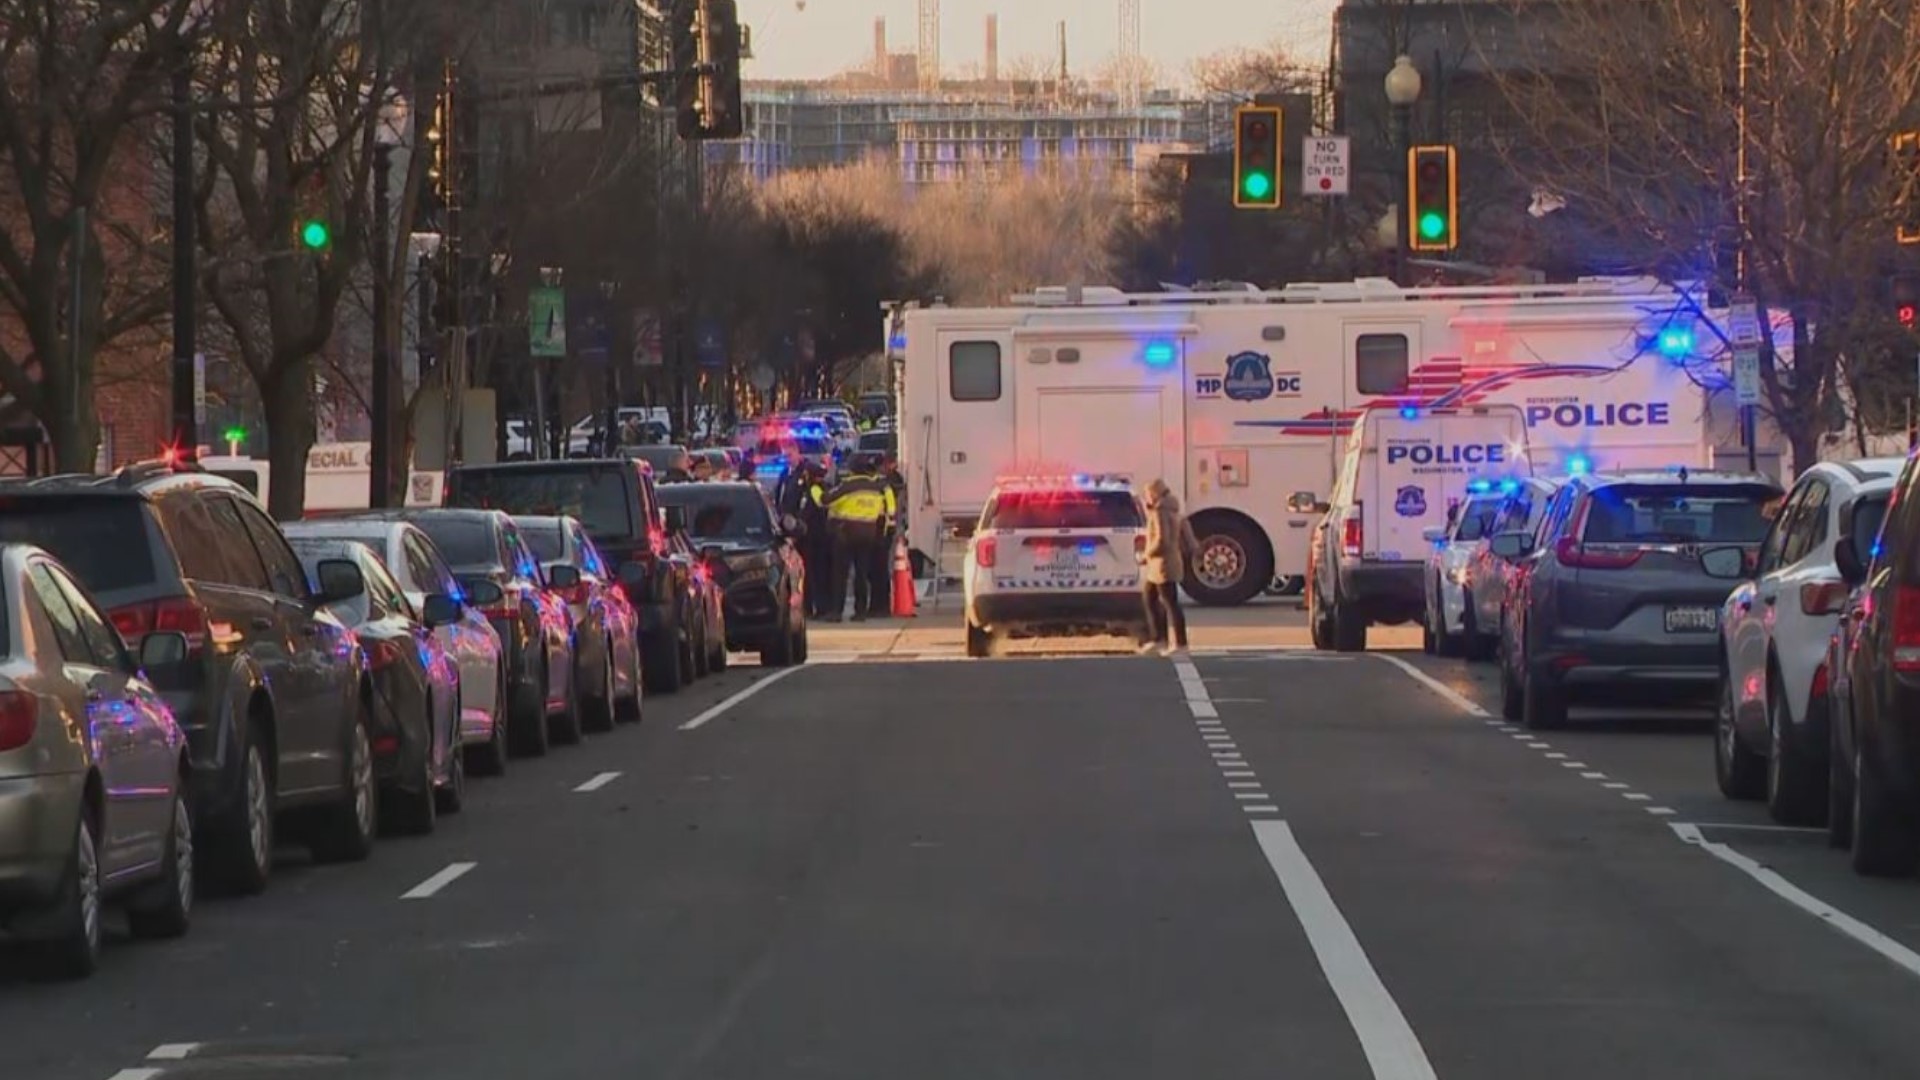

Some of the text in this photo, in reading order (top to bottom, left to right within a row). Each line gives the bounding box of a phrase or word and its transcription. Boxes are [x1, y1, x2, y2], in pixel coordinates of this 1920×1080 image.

[1316, 140, 1337, 153] NO
[1313, 154, 1340, 164] TURN
[1307, 166, 1346, 176] ON RED
[1196, 377, 1301, 393] MP DC
[1526, 402, 1669, 427] POLICE
[1387, 444, 1504, 464] POLICE
[1033, 563, 1097, 571] METROPOLITAN
